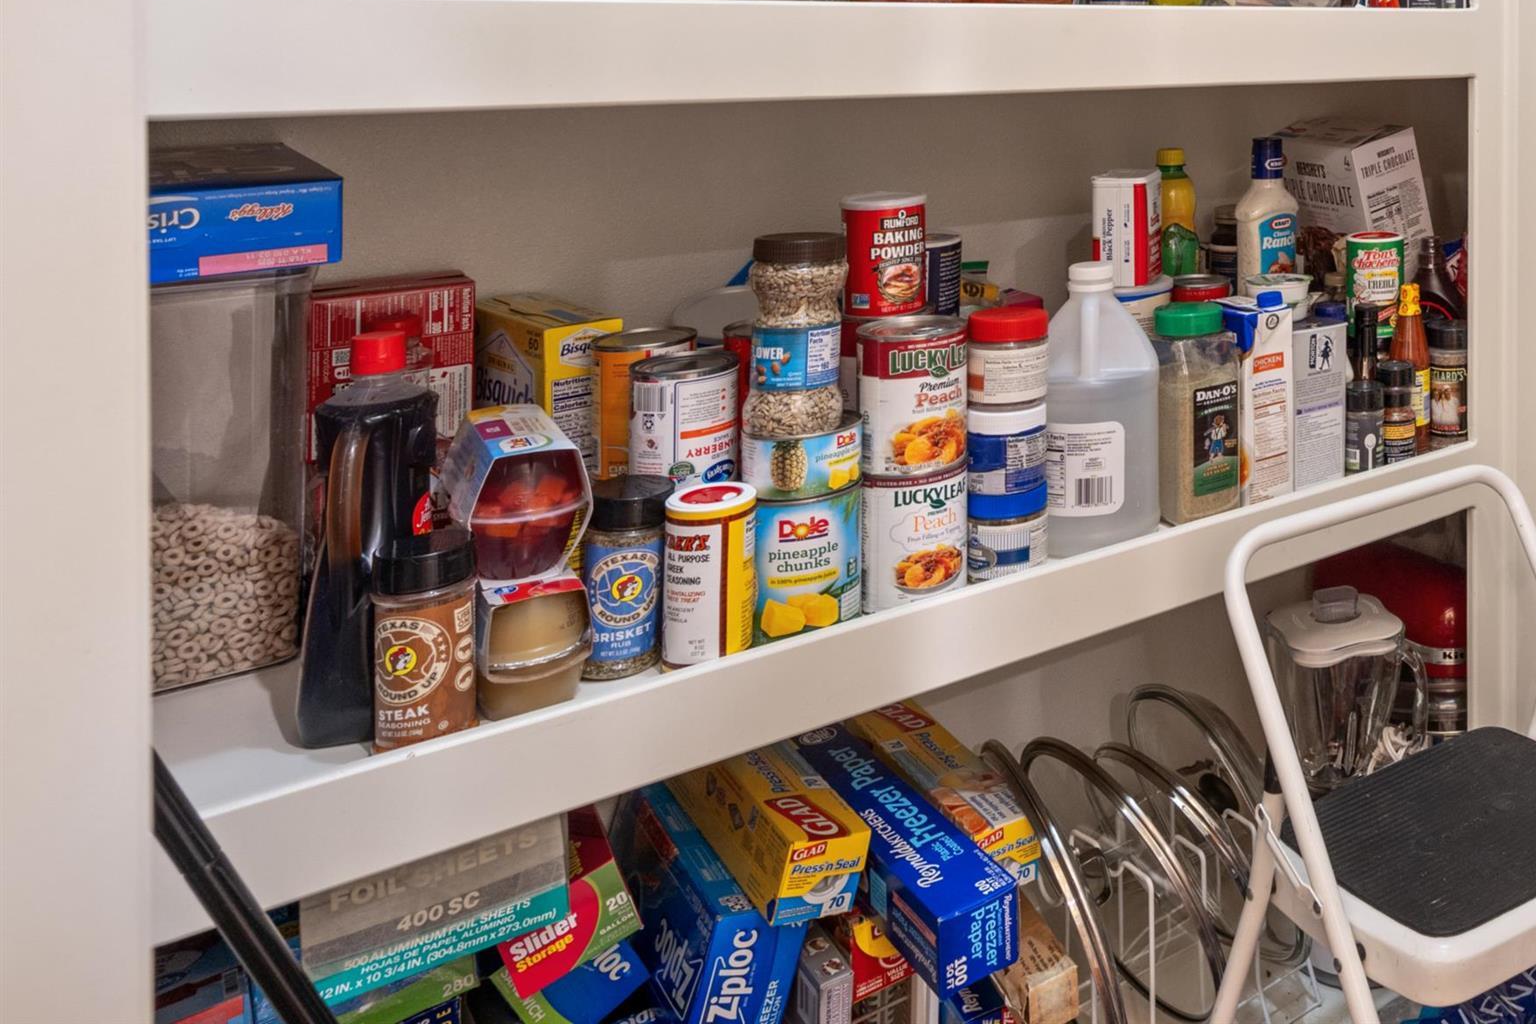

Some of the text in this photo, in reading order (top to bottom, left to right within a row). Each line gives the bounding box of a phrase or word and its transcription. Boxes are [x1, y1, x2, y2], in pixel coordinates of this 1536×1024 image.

[1295, 161, 1327, 179] HERSHEY'S
[1360, 148, 1416, 179] TRIPLE CHOCOLATE
[1306, 180, 1355, 208] CHOCOLATE
[229, 202, 294, 222] Kellogg's
[873, 227, 924, 246] BAKING
[1105, 208, 1115, 261] Black Pepper
[1262, 236, 1296, 251] Ranch
[870, 242, 926, 260] POWDER
[889, 345, 951, 374] LUCKY
[1252, 355, 1283, 369] CHICKEN
[918, 377, 960, 393] Premium
[1195, 384, 1237, 402] DAN-O'S
[914, 387, 963, 408] Peach
[836, 432, 857, 448] Dole
[893, 480, 967, 509] LUCKY LEAF
[778, 516, 830, 540] Dole
[913, 511, 958, 533] Peach
[601, 552, 650, 569] TEXAS
[677, 552, 712, 564] PURPOSE
[768, 541, 840, 564] pineapple
[776, 556, 832, 574] chunks
[597, 609, 642, 624] ROUND
[376, 621, 420, 635] TEXAS
[592, 622, 653, 645] BRISKET
[611, 639, 632, 650] RUB
[420, 669, 438, 692] UP
[378, 703, 430, 722] STEAK
[378, 717, 431, 730] SEASONING
[827, 746, 941, 848] Freezer Paper
[767, 796, 838, 837] GLAD
[976, 831, 1003, 850] GLAD
[792, 843, 827, 861] GLAD
[791, 855, 861, 876] Press'n Seal
[1016, 867, 1031, 881] 70
[329, 875, 407, 913] FOIL
[605, 890, 627, 912] 20
[828, 894, 845, 910] 70
[397, 890, 482, 933] 400 SC
[367, 897, 532, 962] ALUMINUM FOIL SHEETS
[599, 910, 635, 936] GALLON
[967, 906, 986, 960] Paper
[985, 899, 1001, 967] Freezer
[360, 913, 517, 975] HOJAS DE PAPEL ALUMINIO
[425, 907, 558, 965] (304.8mm 273.0mm)
[509, 913, 579, 962] Slider
[515, 933, 575, 974] Storage
[706, 928, 758, 1023] Ziploc
[954, 955, 968, 987] 100
[441, 974, 475, 997] 280
